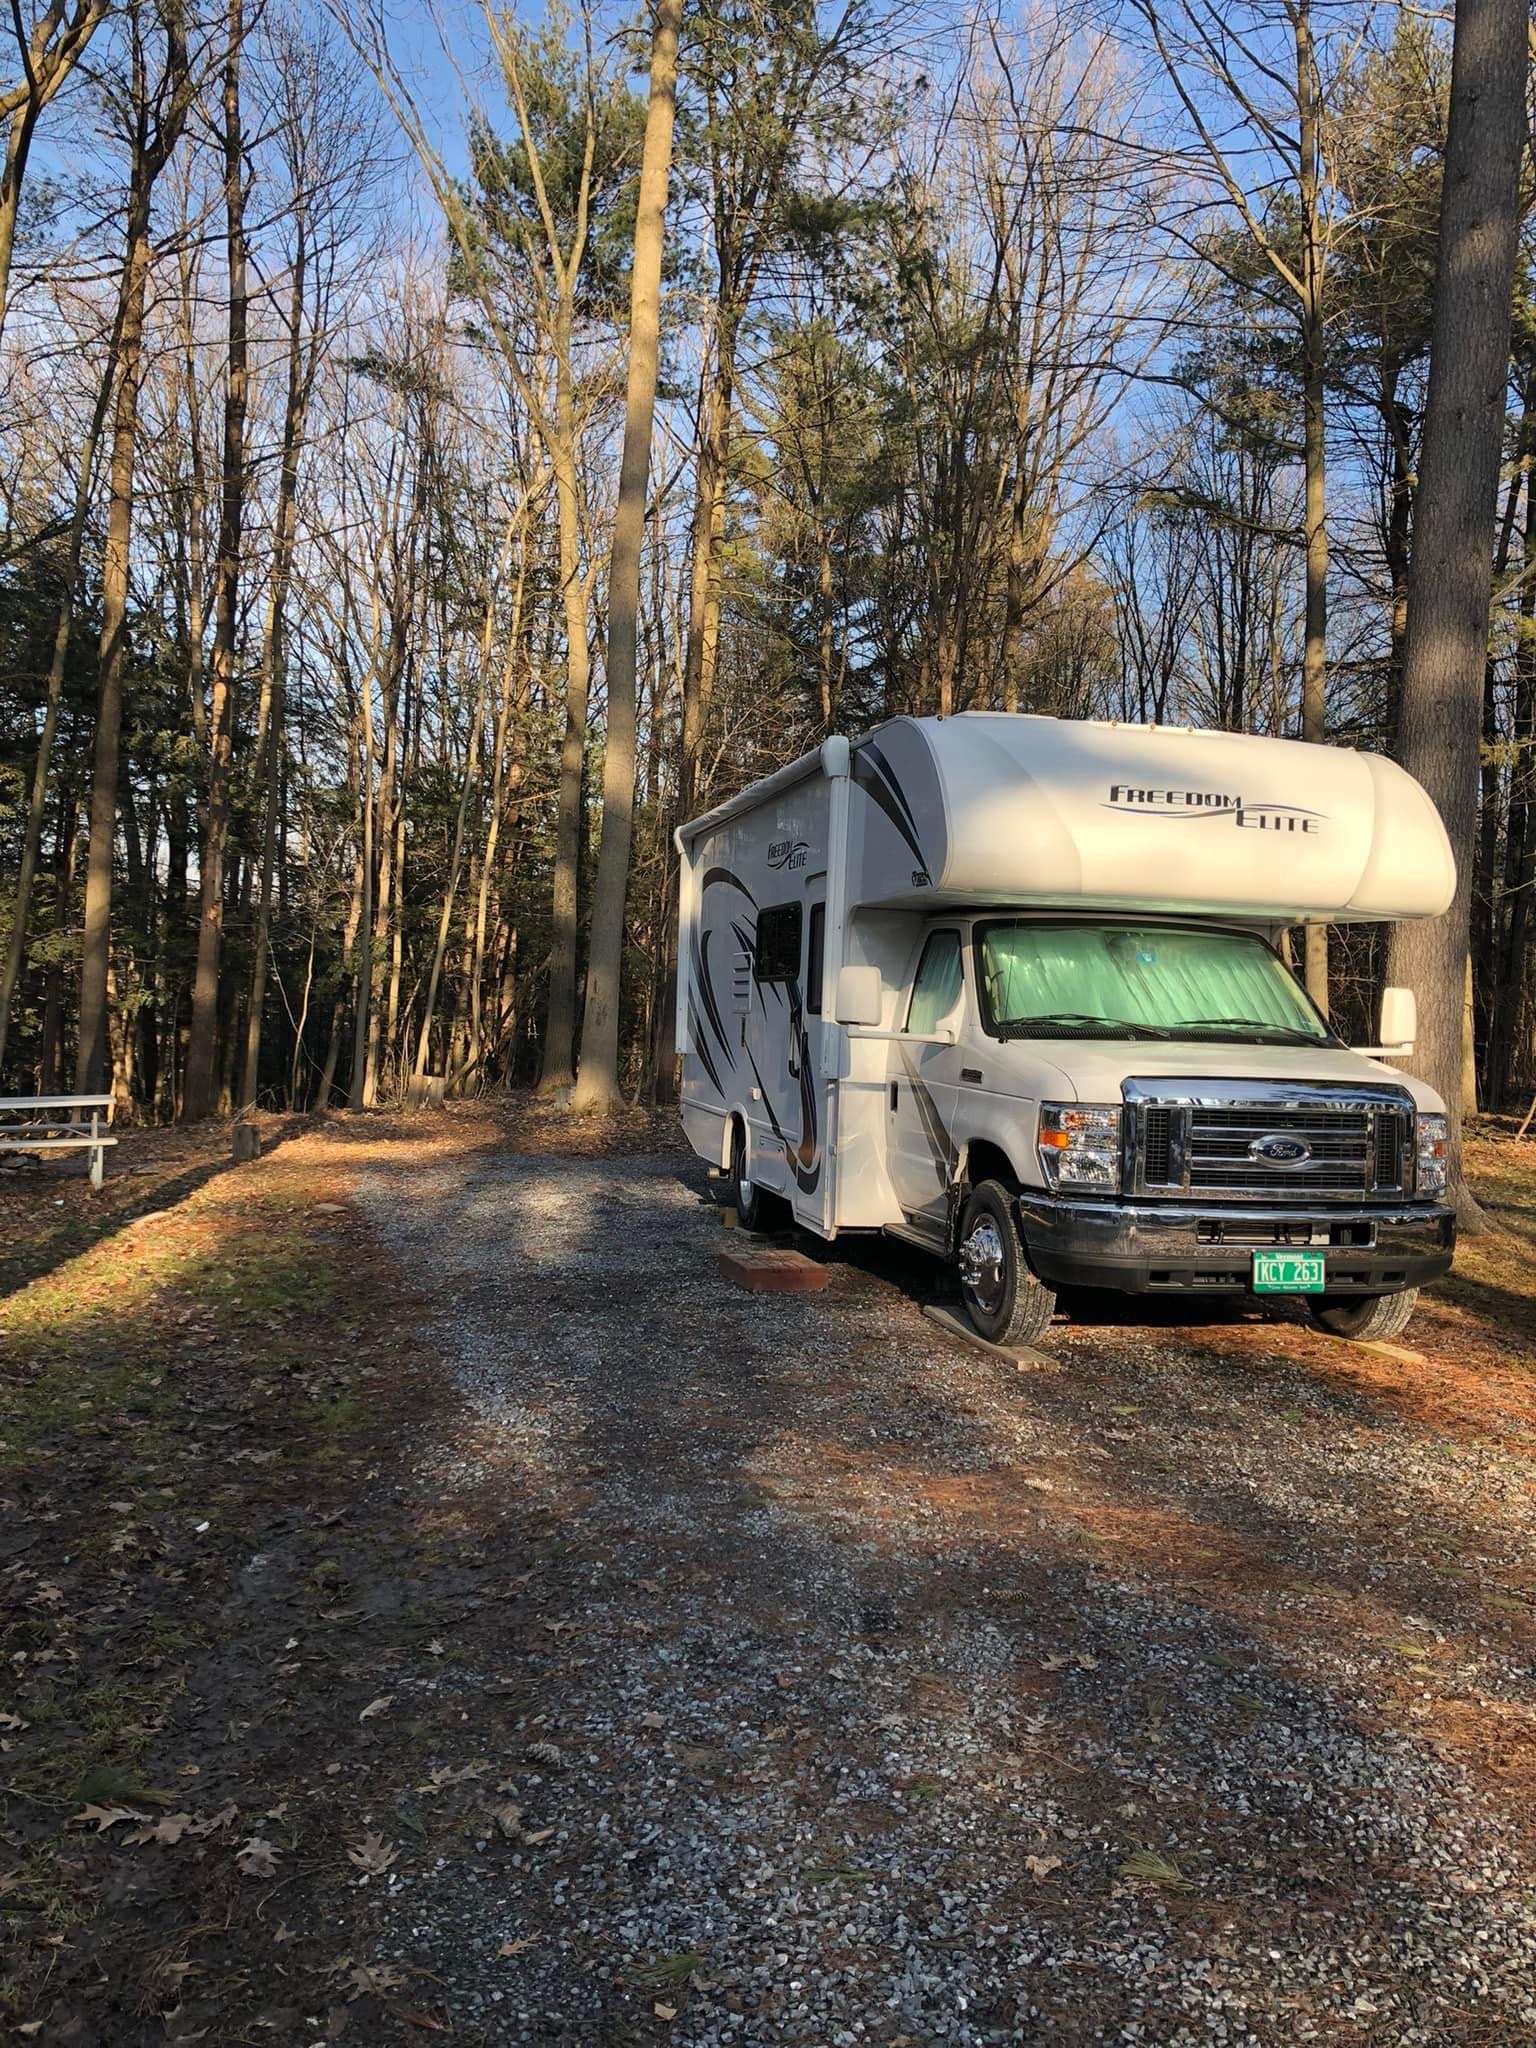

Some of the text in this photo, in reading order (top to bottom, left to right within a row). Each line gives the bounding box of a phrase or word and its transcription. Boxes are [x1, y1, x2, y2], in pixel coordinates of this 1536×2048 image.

[1109, 784, 1242, 809] FREEDOM
[1236, 809, 1320, 834] ELITE
[788, 851, 807, 870] ELITE
[1270, 1143, 1298, 1157] Ford
[1261, 1261, 1318, 1281] KCY 263
